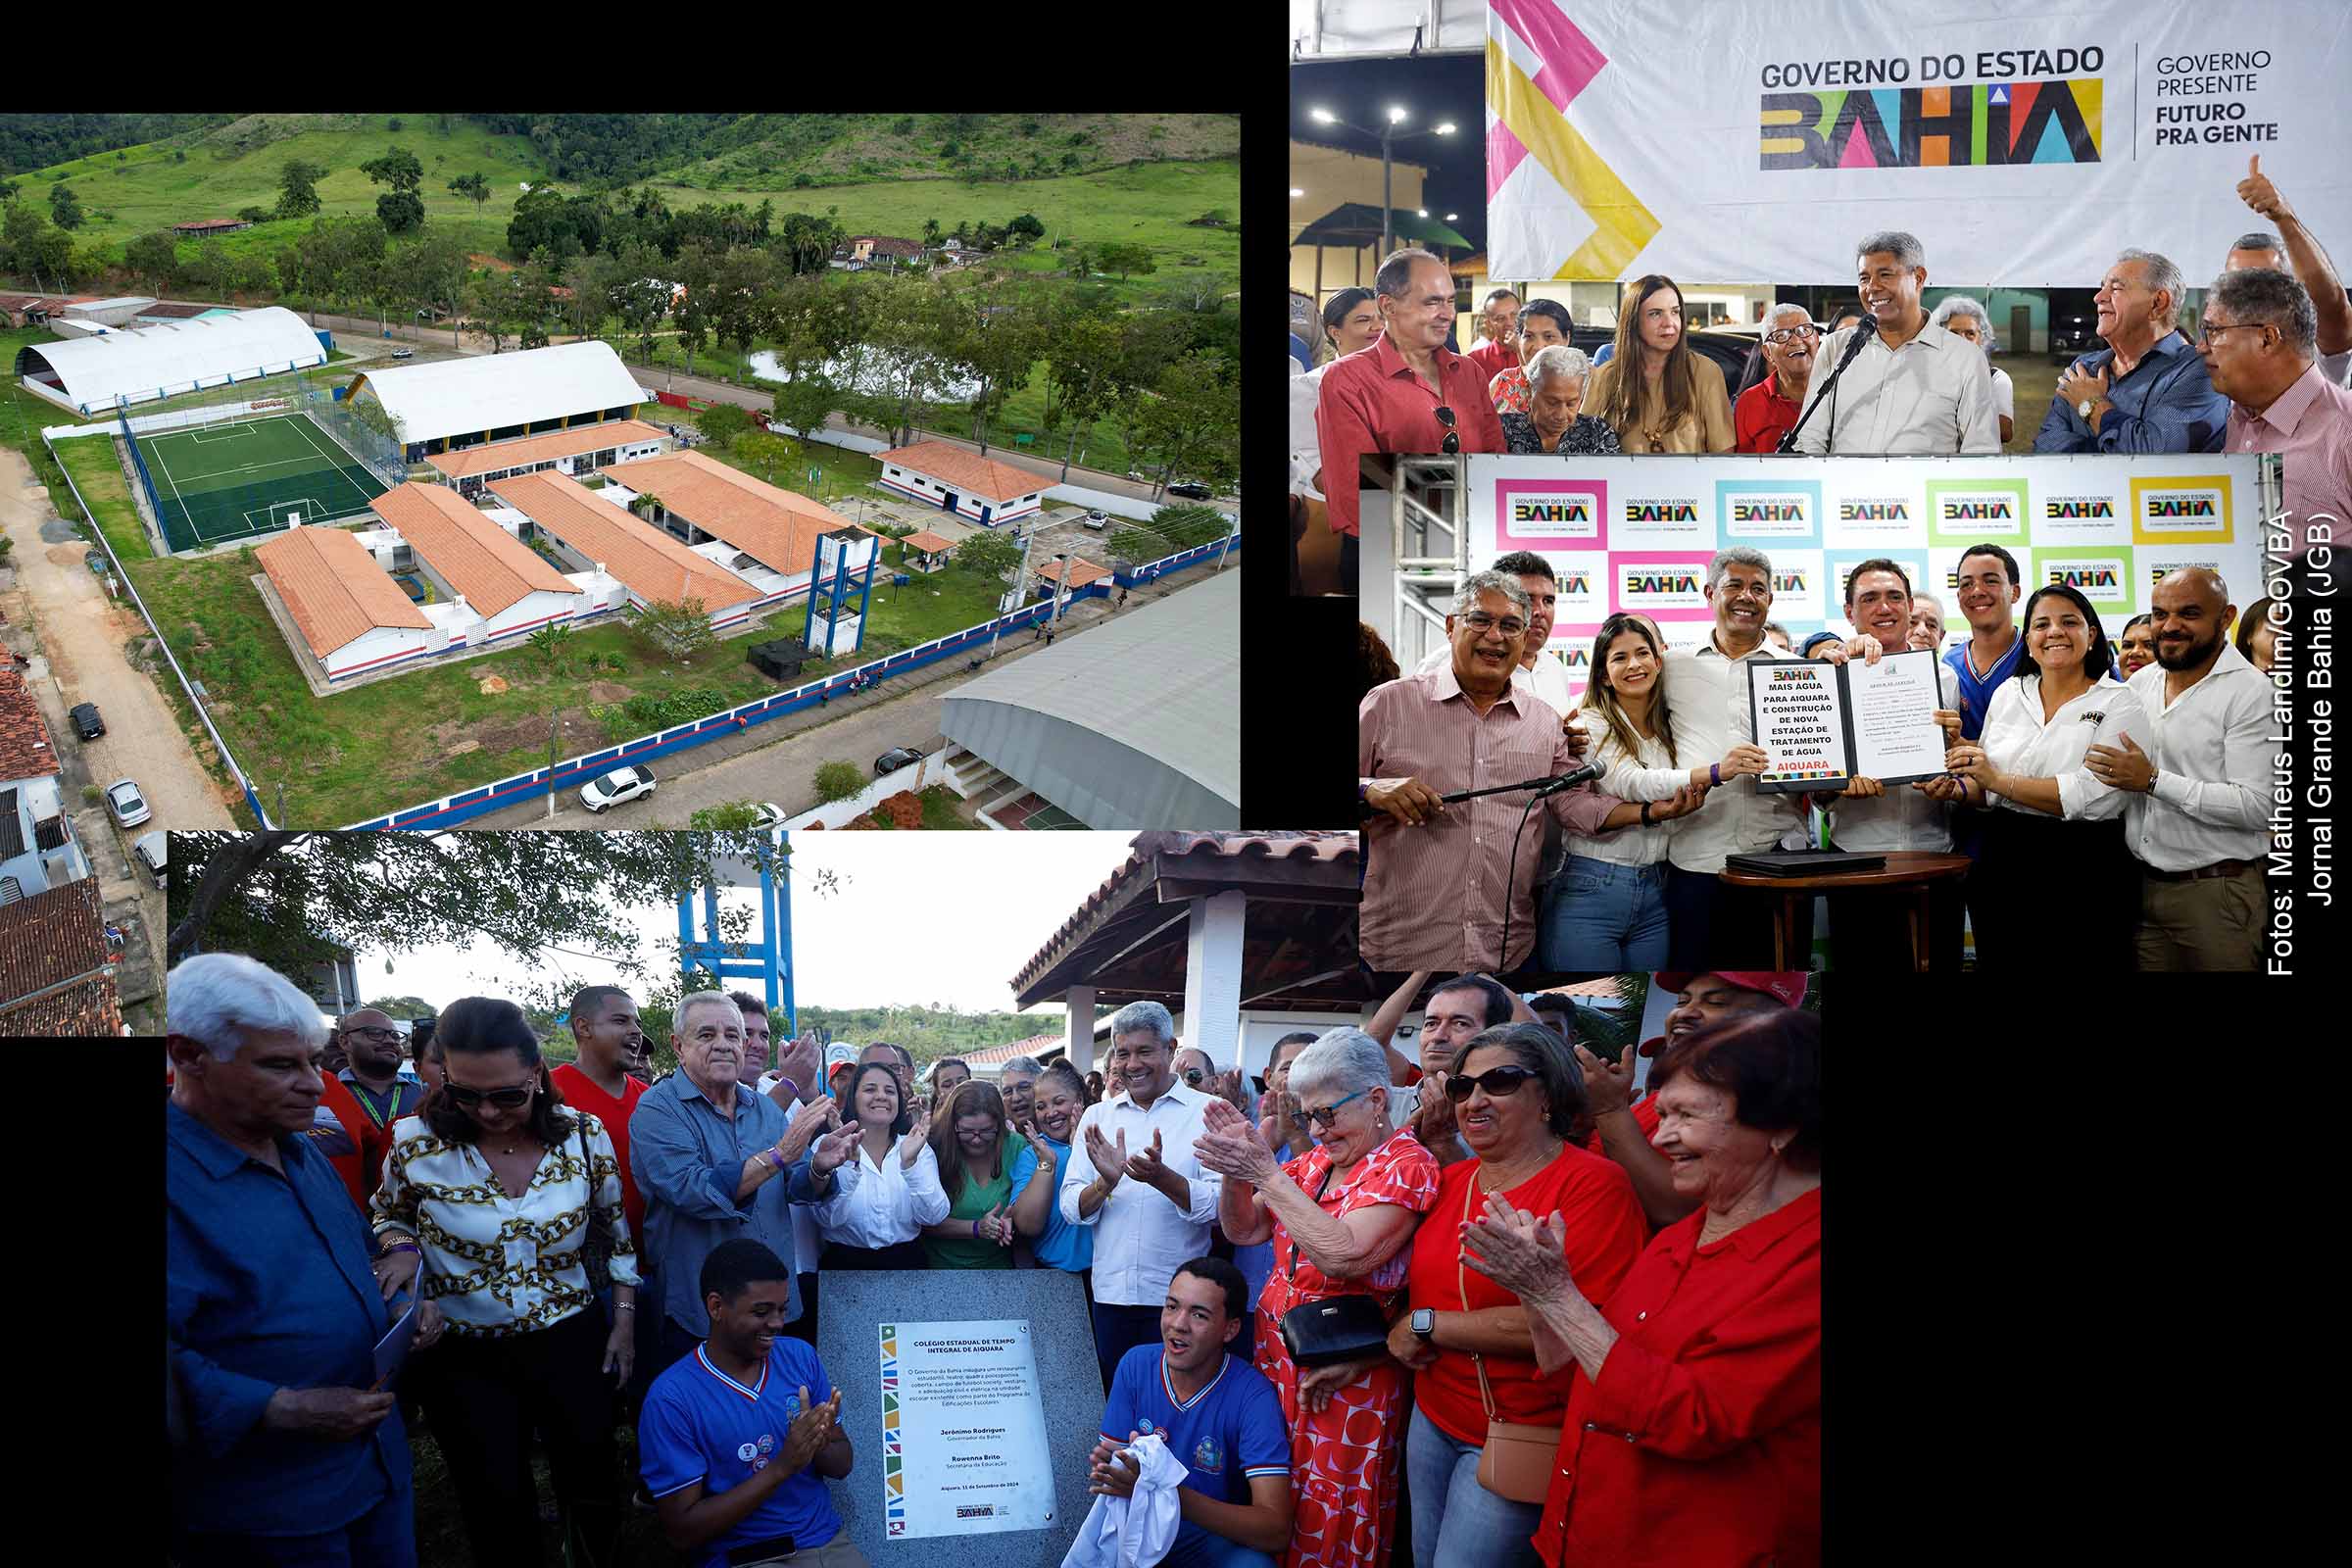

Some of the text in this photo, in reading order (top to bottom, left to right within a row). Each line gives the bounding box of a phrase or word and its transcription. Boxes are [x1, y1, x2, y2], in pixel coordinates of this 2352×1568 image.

[1762, 47, 2103, 87] GOVERNO DO ESTADO
[2157, 51, 2271, 74] GOVERNO
[2158, 74, 2257, 96] PRESENTE
[2156, 103, 2245, 123] FUTURO
[1761, 78, 2103, 171] BAHIA
[2156, 123, 2278, 145] PRA GENTE
[1516, 506, 1588, 521] BAHIA
[1627, 506, 1697, 521] BAHIA
[1735, 506, 1803, 521] BAHIA
[1840, 505, 1908, 520] BAHIA
[1944, 504, 2011, 519] BAHIA
[2047, 503, 2114, 517] BAHIA
[2148, 502, 2215, 516] BAHIA
[1554, 577, 1590, 593] HIA
[1628, 576, 1698, 593] BAHIA
[2050, 571, 2117, 586] BAHIA
[1774, 670, 1816, 681] BAHIA
[1772, 705, 1833, 713] CONSTRUÇÃO
[1772, 726, 1813, 735] ESTAÇÃO
[1777, 760, 1829, 770] AIQUARA
